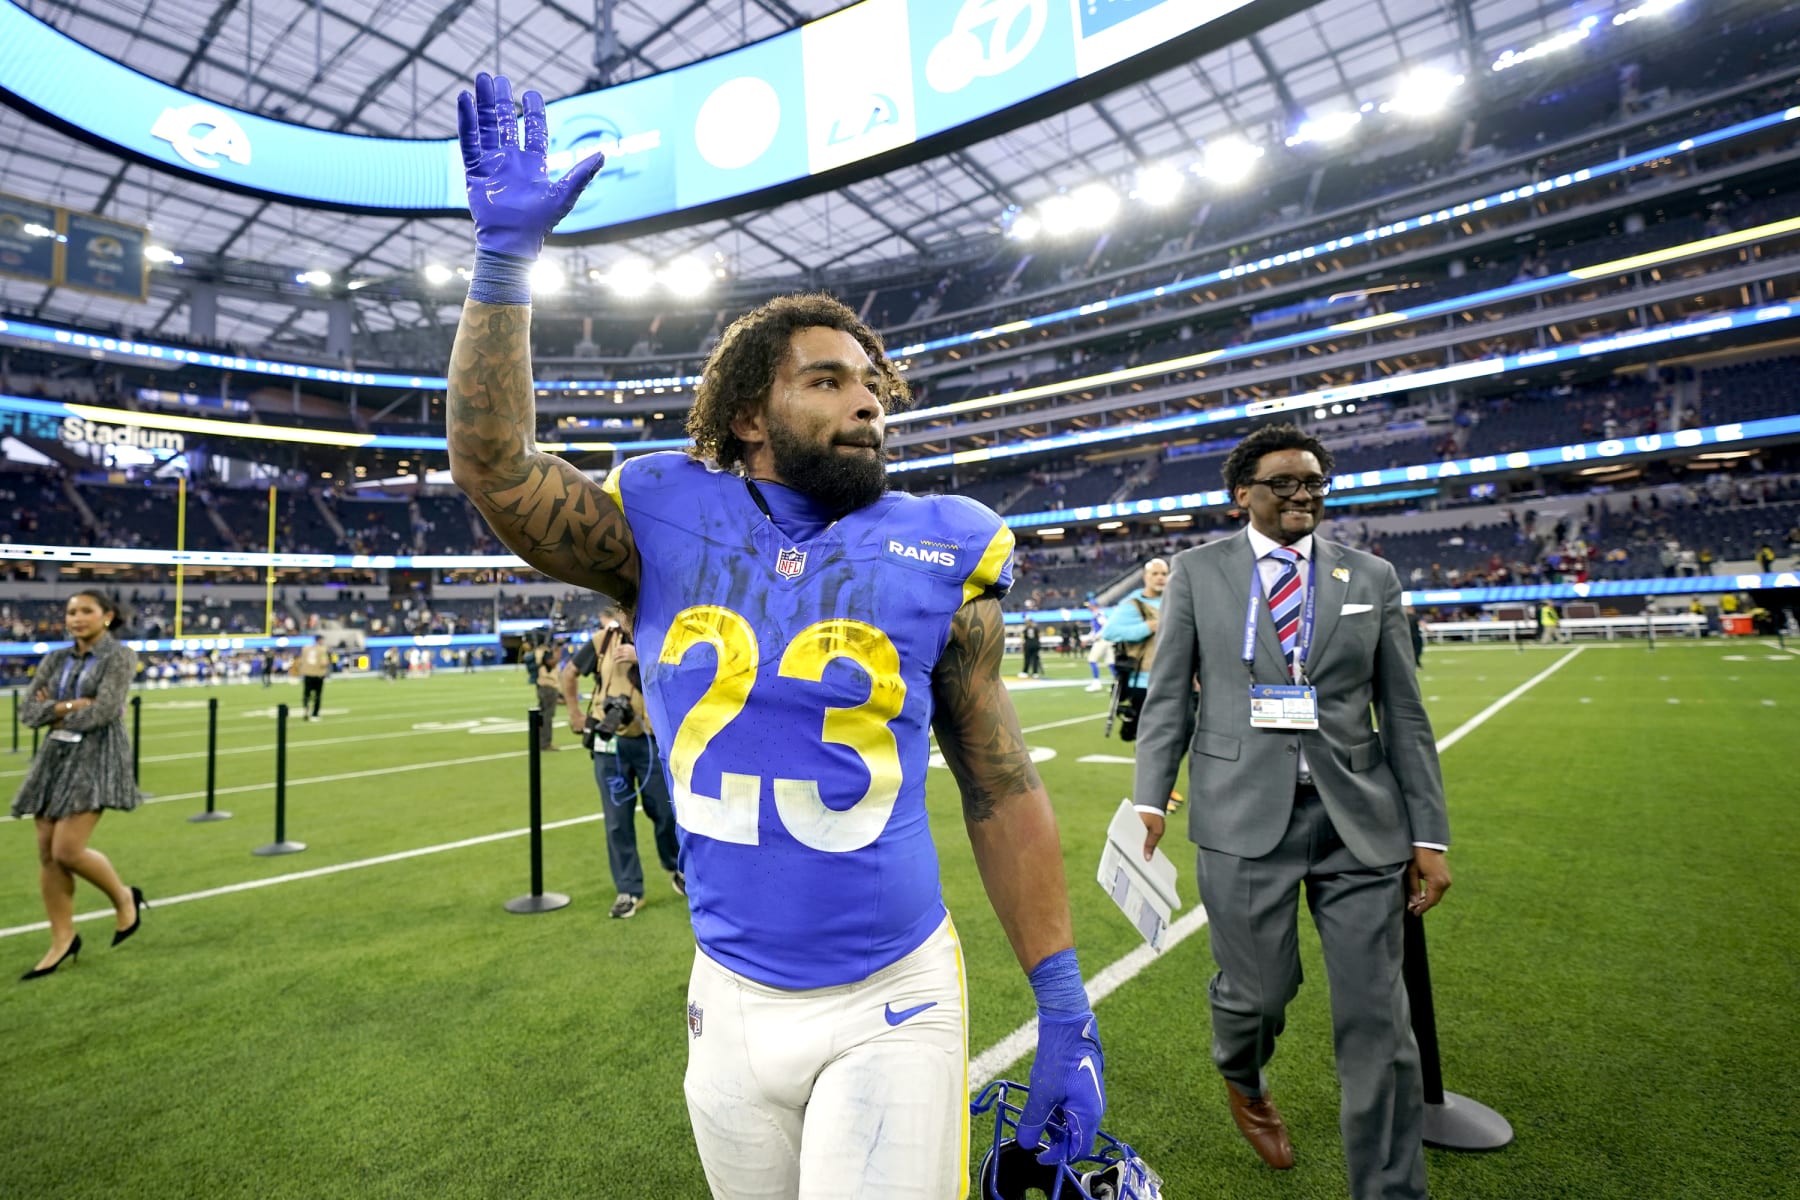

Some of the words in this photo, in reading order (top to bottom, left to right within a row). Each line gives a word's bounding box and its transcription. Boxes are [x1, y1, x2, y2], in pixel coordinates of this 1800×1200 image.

[63, 415, 185, 451] Stadium
[1073, 490, 1225, 520] WELCOME
[1334, 471, 1382, 490] HE
[1406, 452, 1530, 481] RAMS
[1561, 423, 1744, 461] HOUSE
[780, 560, 799, 574] NFL
[888, 540, 956, 567] RAMS
[657, 604, 907, 853] 23
